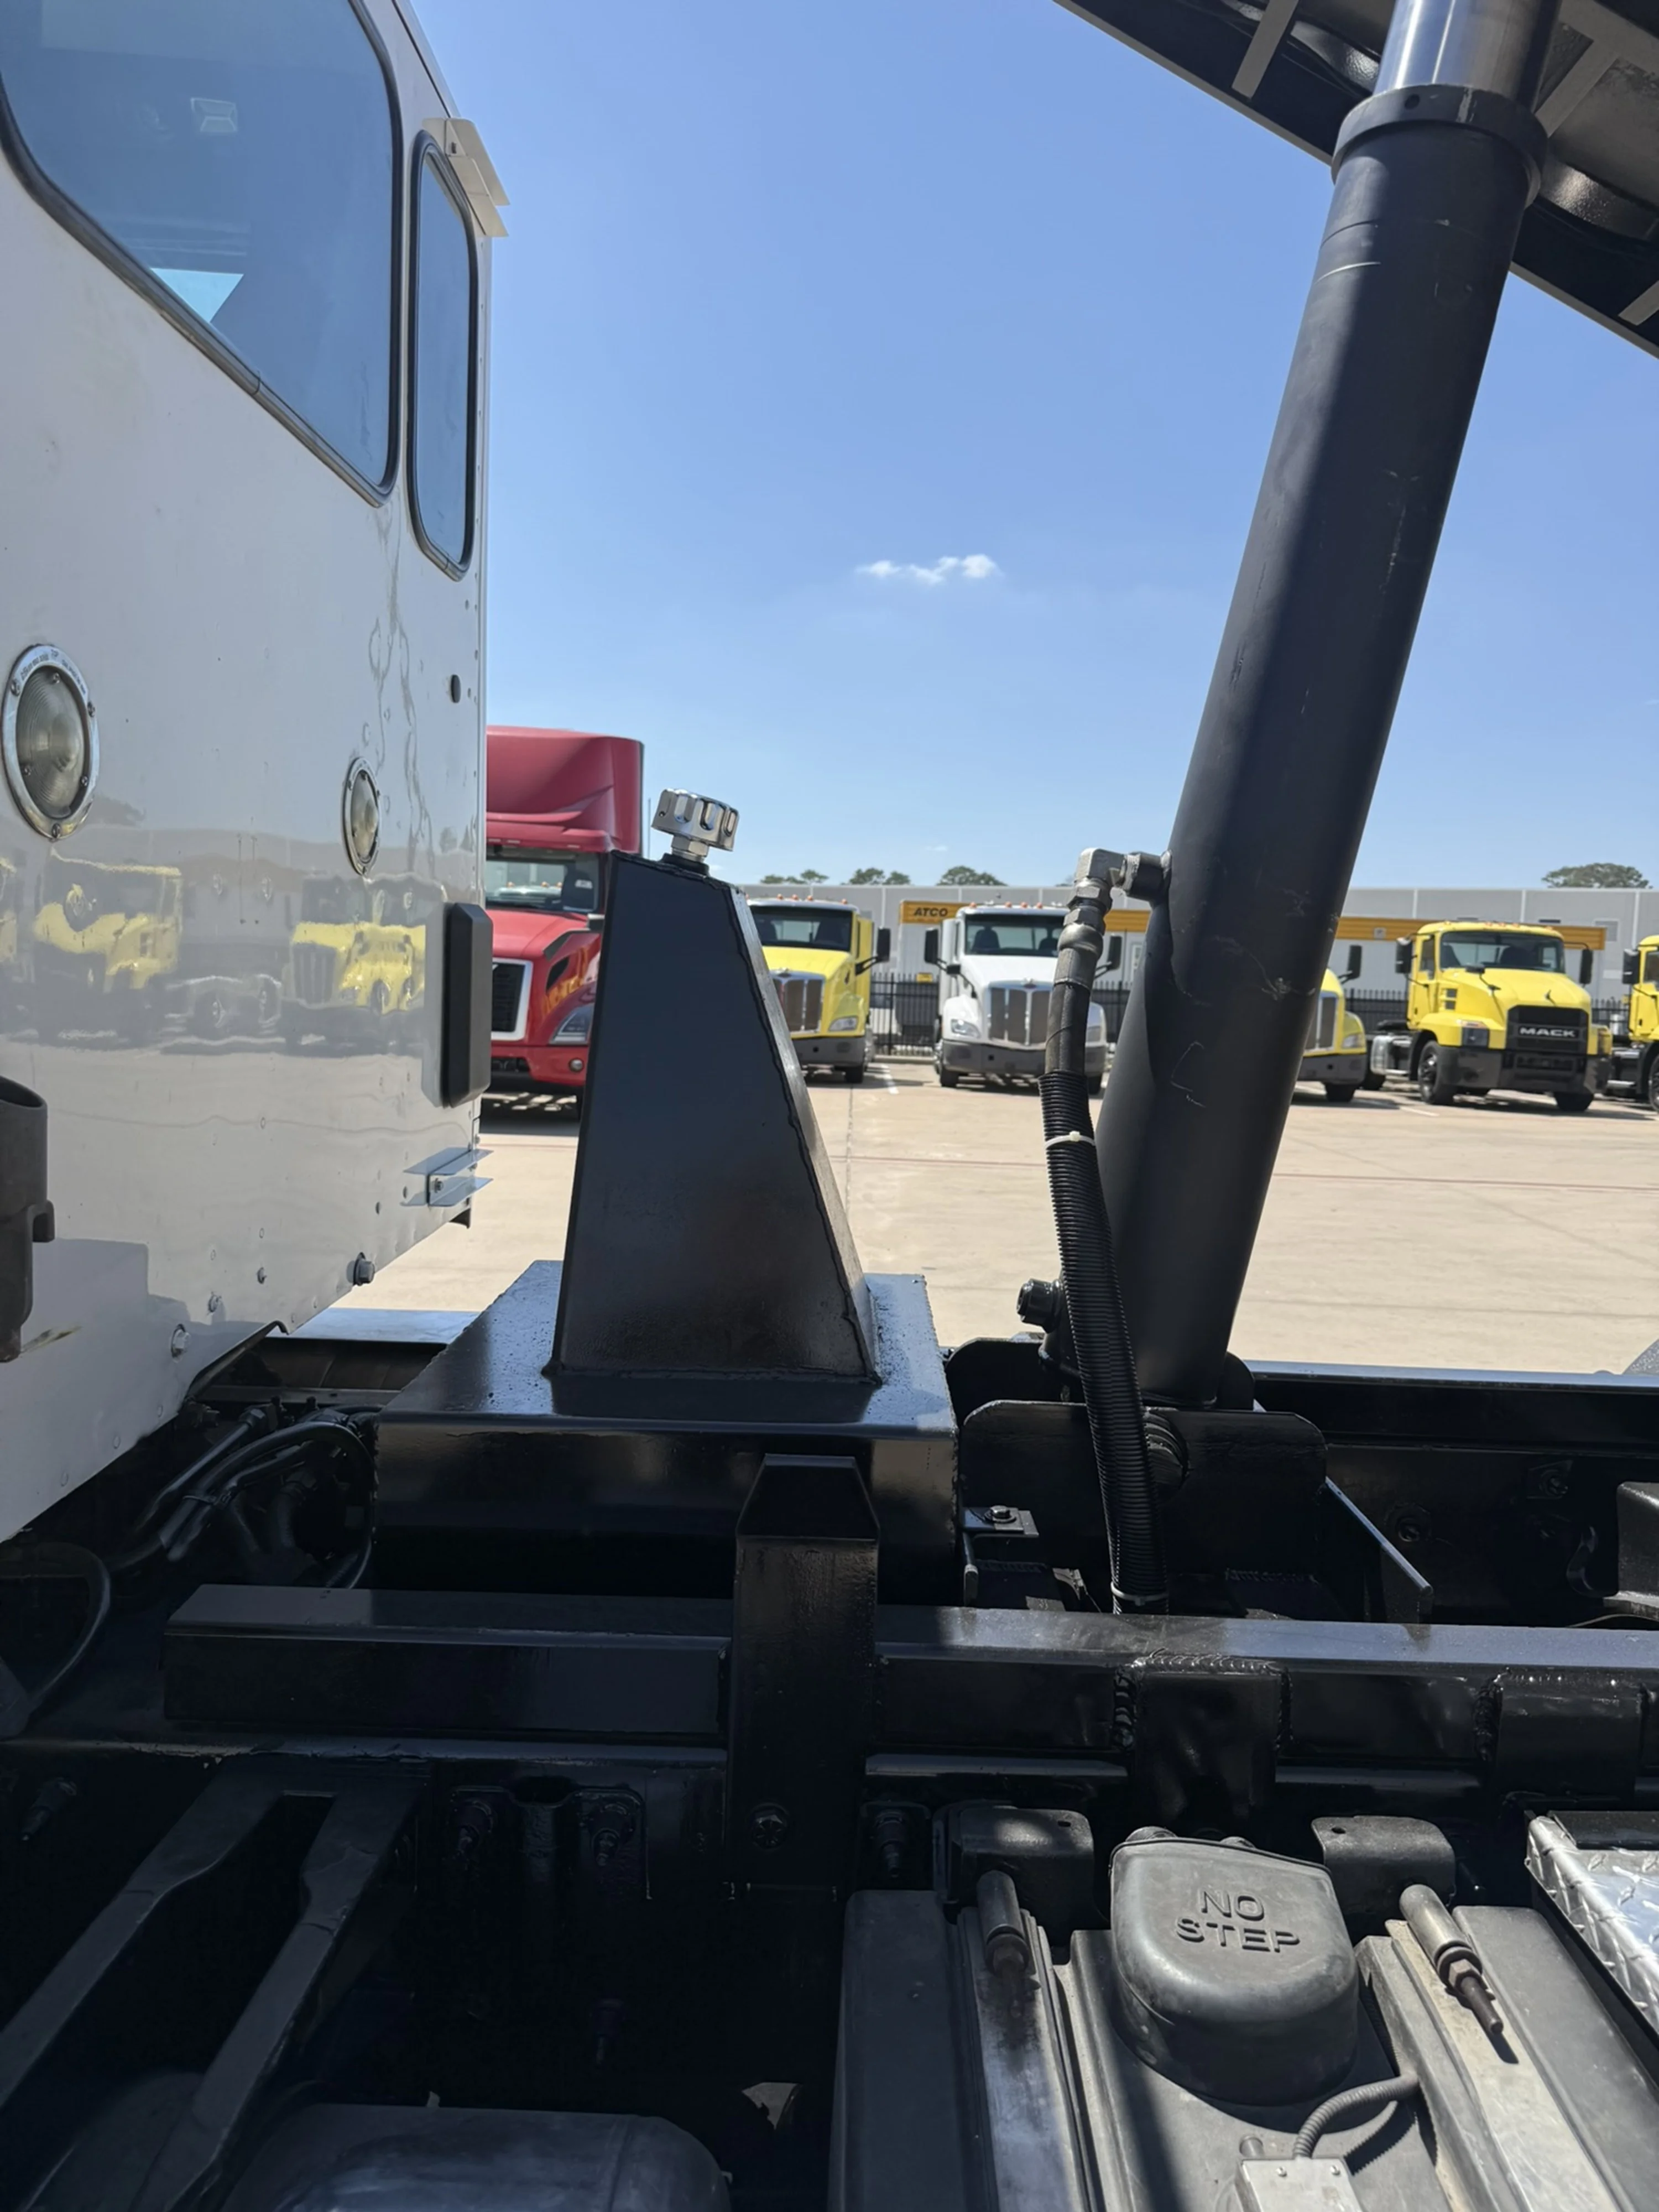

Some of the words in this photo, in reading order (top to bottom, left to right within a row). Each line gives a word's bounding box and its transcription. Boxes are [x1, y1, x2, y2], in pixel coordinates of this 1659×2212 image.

[914, 907, 948, 917] ATCO
[1520, 1027, 1575, 1037] MACK
[1199, 1888, 1265, 1922] NO
[1176, 1916, 1300, 1953] STEP
